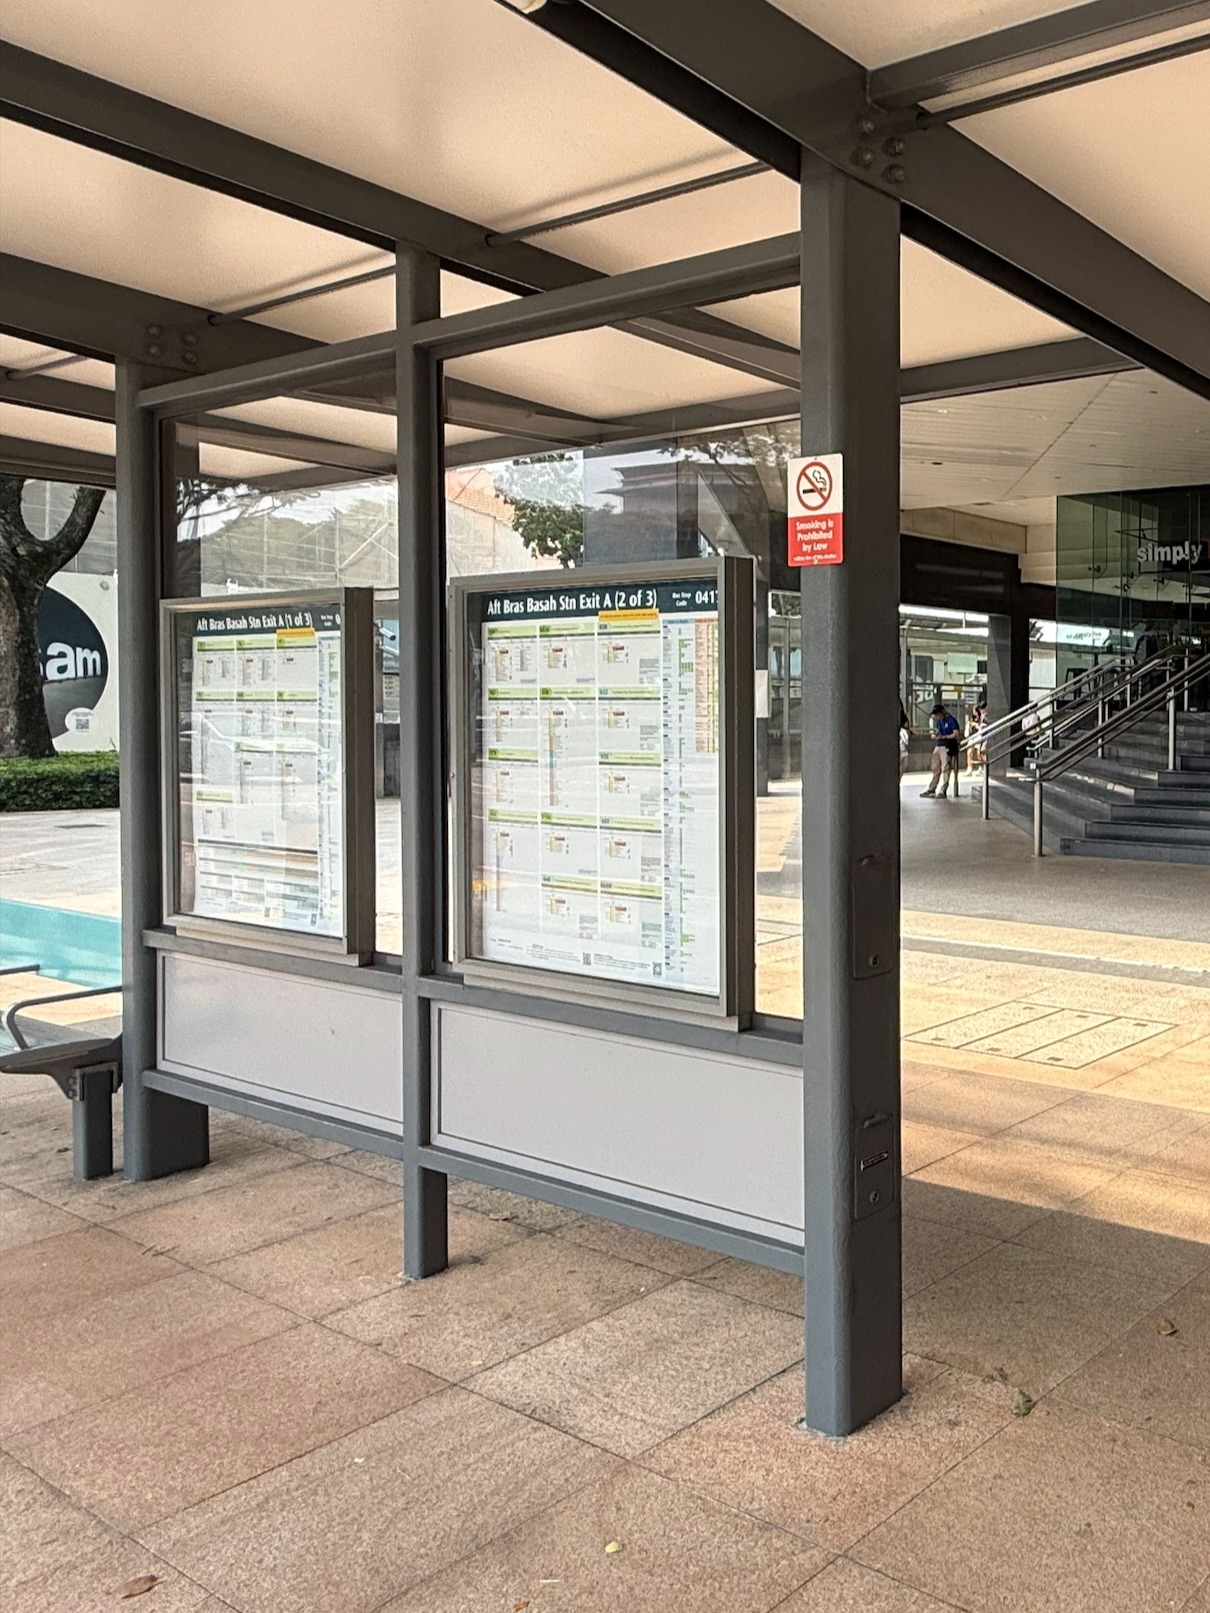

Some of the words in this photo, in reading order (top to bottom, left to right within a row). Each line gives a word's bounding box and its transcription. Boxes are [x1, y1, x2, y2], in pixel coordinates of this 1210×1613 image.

[796, 520, 826, 531] Smoking
[797, 529, 833, 542] Prohibited
[802, 542, 812, 553] by
[813, 542, 828, 551] Law
[1136, 540, 1203, 565] simply
[487, 598, 501, 615] Aft
[503, 599, 524, 614] Bras
[527, 595, 556, 612] Basah
[560, 595, 576, 611] Stn
[580, 592, 600, 609] Exit
[603, 593, 612, 608] A
[615, 590, 627, 611] (2
[629, 589, 643, 607] of
[645, 588, 657, 609] 3)
[197, 618, 208, 631] Aft
[209, 618, 225, 631] Bras
[226, 615, 248, 630] Basah
[249, 615, 261, 629] Stn
[262, 614, 277, 628] Exit
[278, 614, 285, 627] A
[285, 613, 293, 629] (1
[295, 612, 302, 626] of
[305, 612, 313, 628] 3)
[39, 641, 101, 681] am
